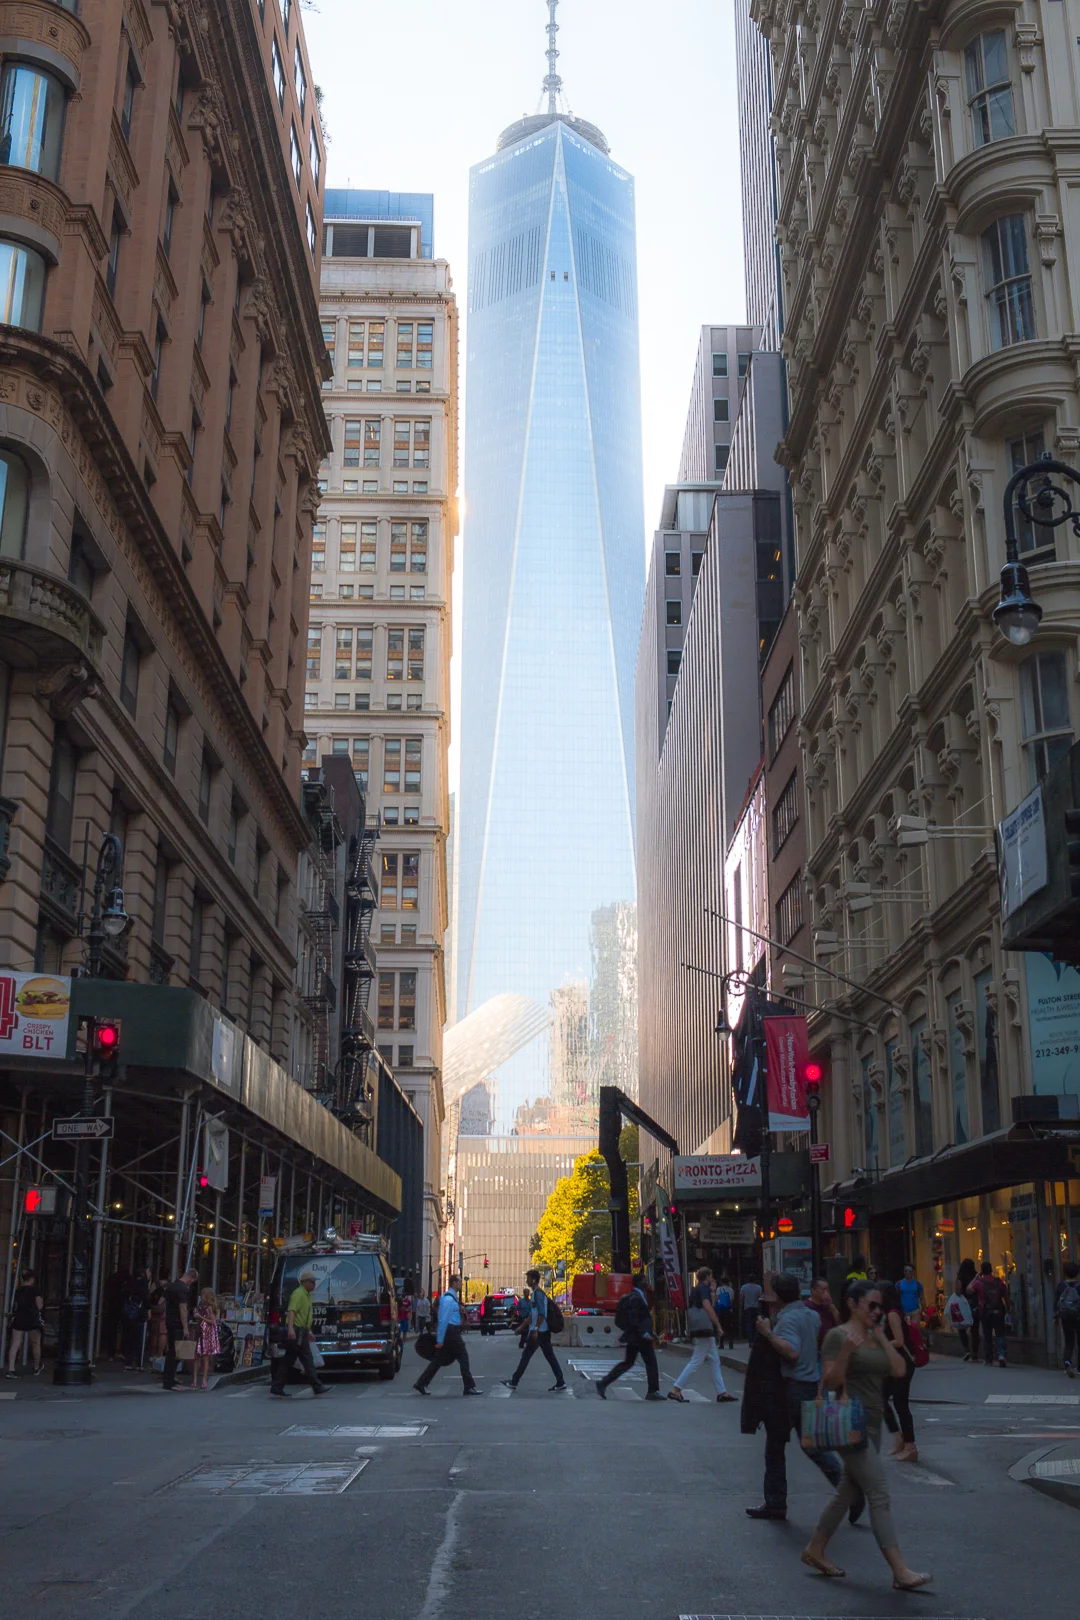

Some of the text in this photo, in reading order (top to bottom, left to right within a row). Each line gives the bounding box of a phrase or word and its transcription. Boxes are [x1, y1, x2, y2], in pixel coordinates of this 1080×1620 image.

[1038, 996, 1061, 1005] FULTON
[23, 1028, 54, 1036] CHICKEN
[23, 1035, 54, 1051] BLT
[61, 1123, 104, 1133] ONE WAY
[677, 1163, 757, 1178] PRONTO PIZZA
[692, 1177, 745, 1186] 212-732-4131
[312, 1264, 328, 1273] Day
[330, 1279, 347, 1287] Nite
